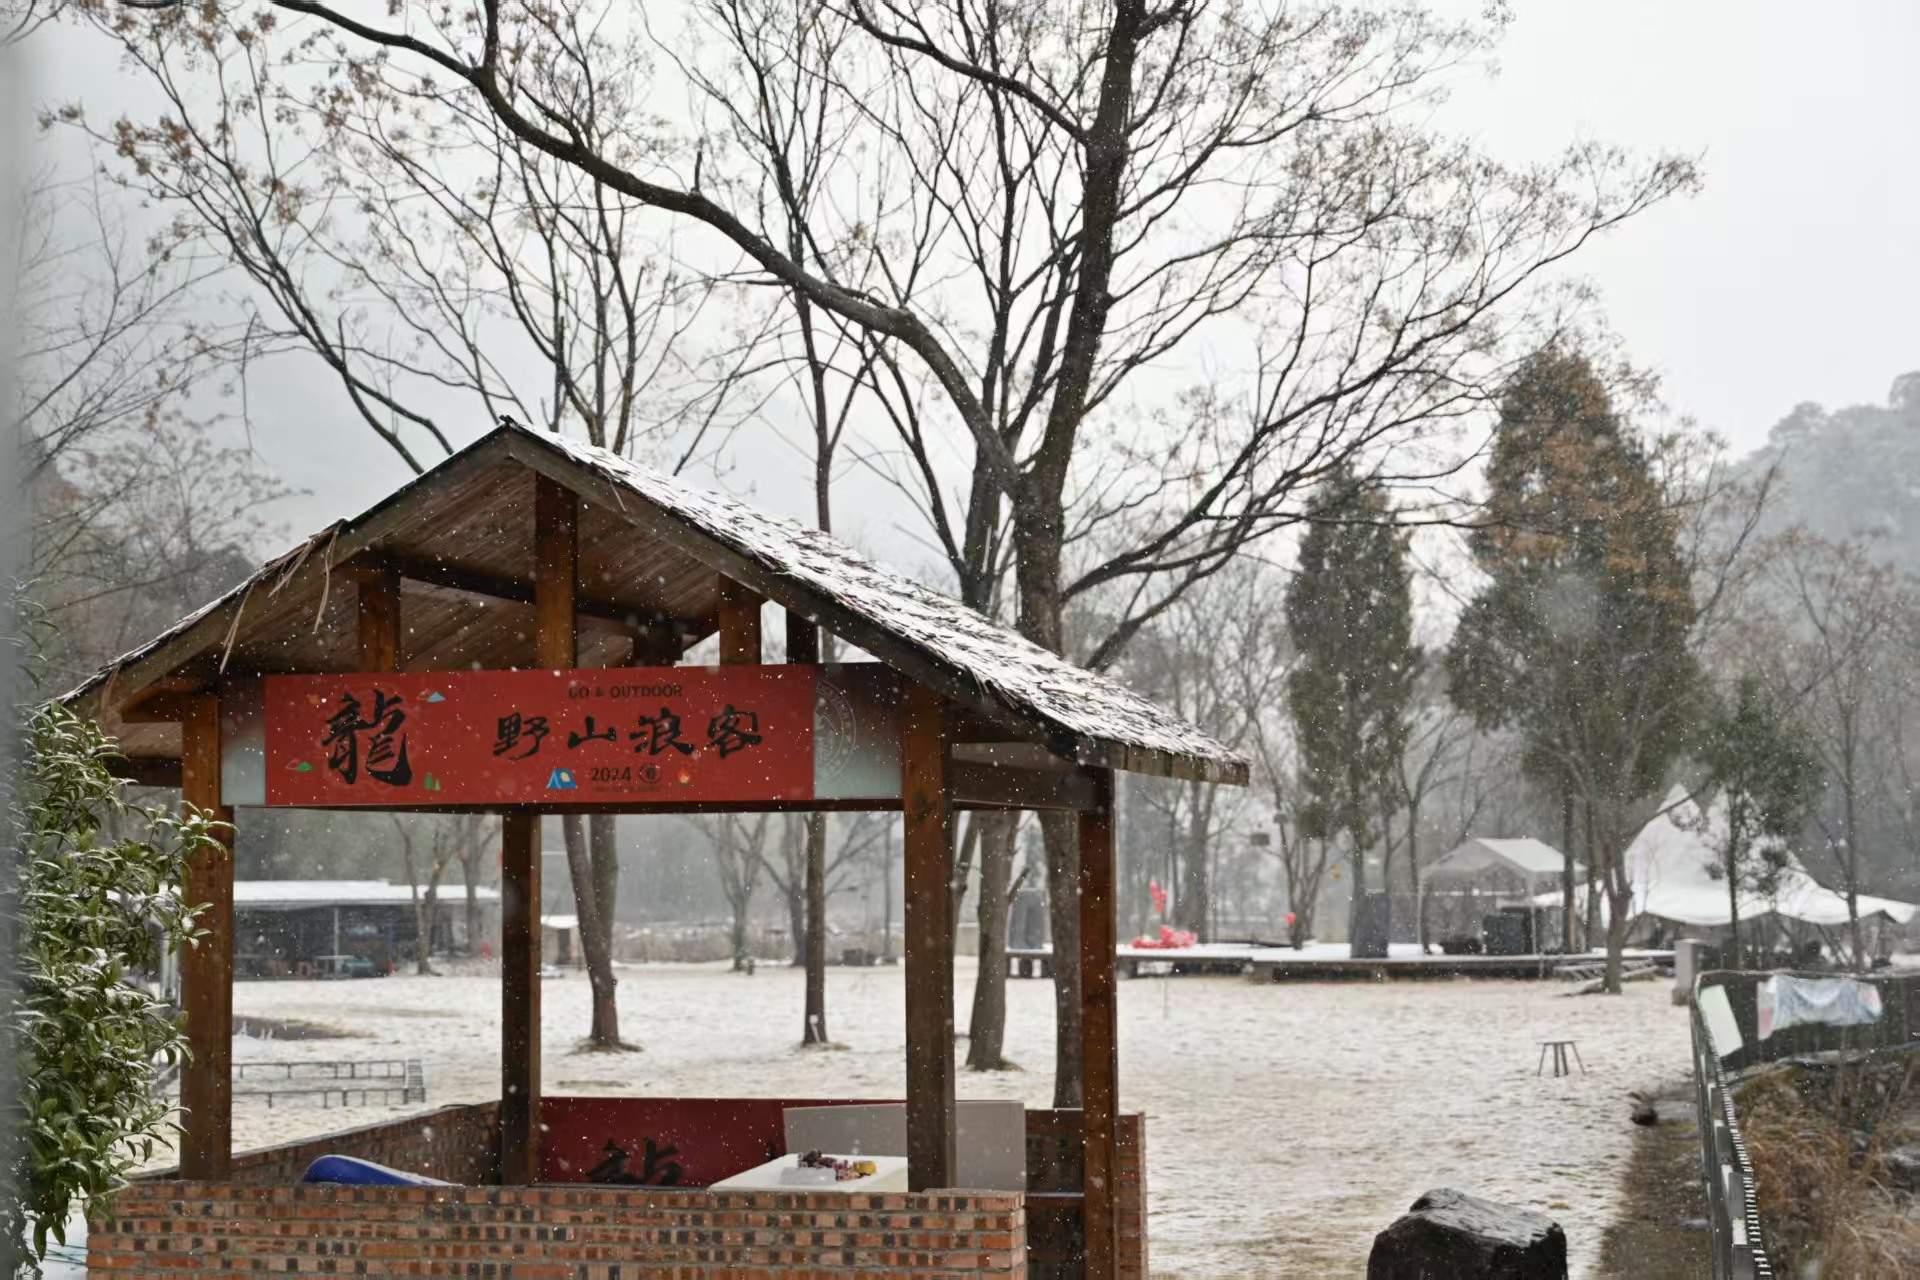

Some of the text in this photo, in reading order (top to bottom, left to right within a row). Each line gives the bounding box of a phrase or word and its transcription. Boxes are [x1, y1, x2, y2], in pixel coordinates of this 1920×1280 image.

[568, 686, 590, 698] GO
[610, 684, 682, 698] OUTDOOR
[493, 704, 762, 761] 野山浪客
[591, 766, 632, 782] 2024
